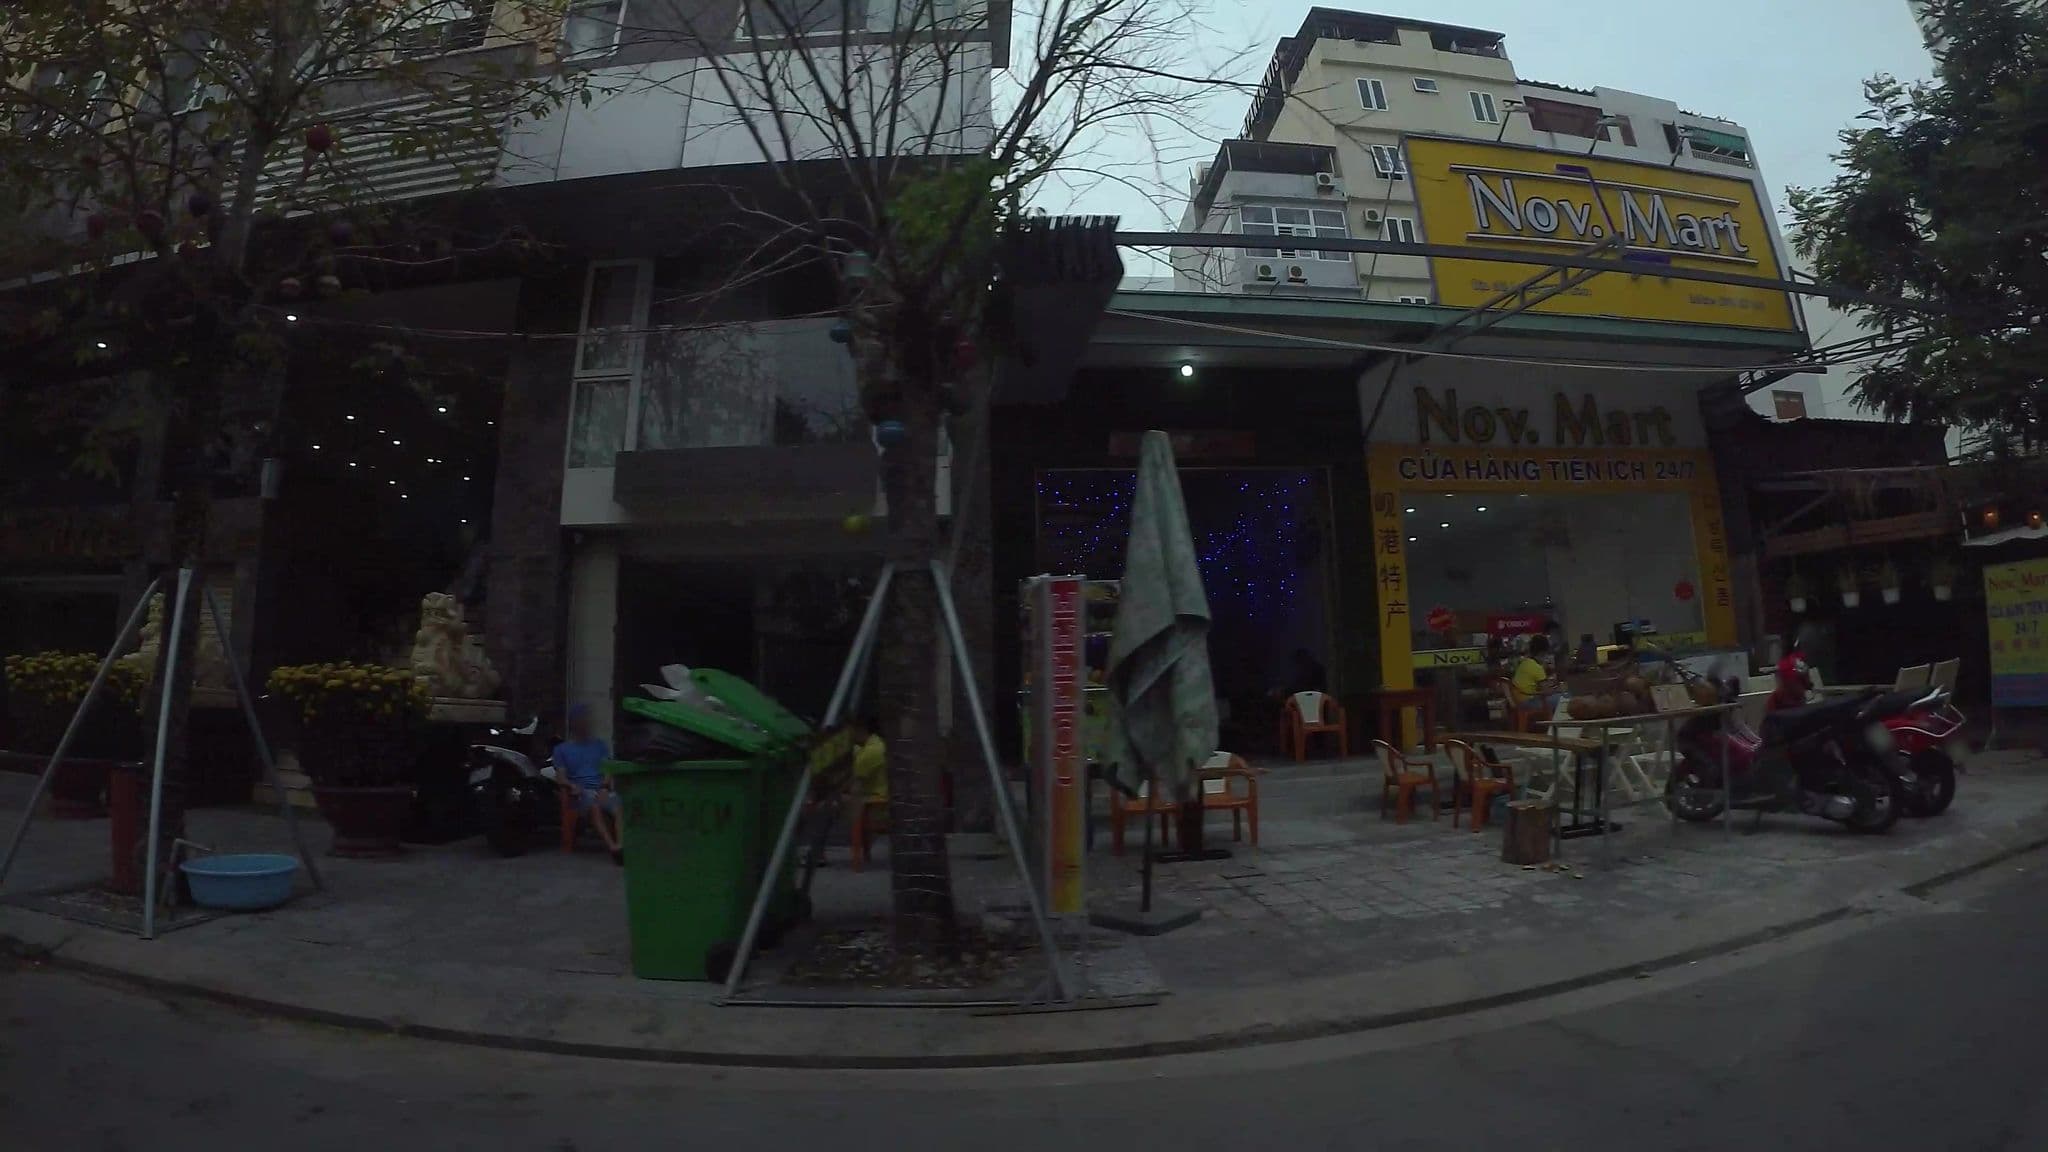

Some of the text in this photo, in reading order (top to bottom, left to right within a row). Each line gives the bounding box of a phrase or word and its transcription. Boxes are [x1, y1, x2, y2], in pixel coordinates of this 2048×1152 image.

[1467, 173, 1747, 254] Nov. Mart
[1414, 386, 1674, 445] Nov. Mart
[1465, 454, 1541, 481] HÀNG
